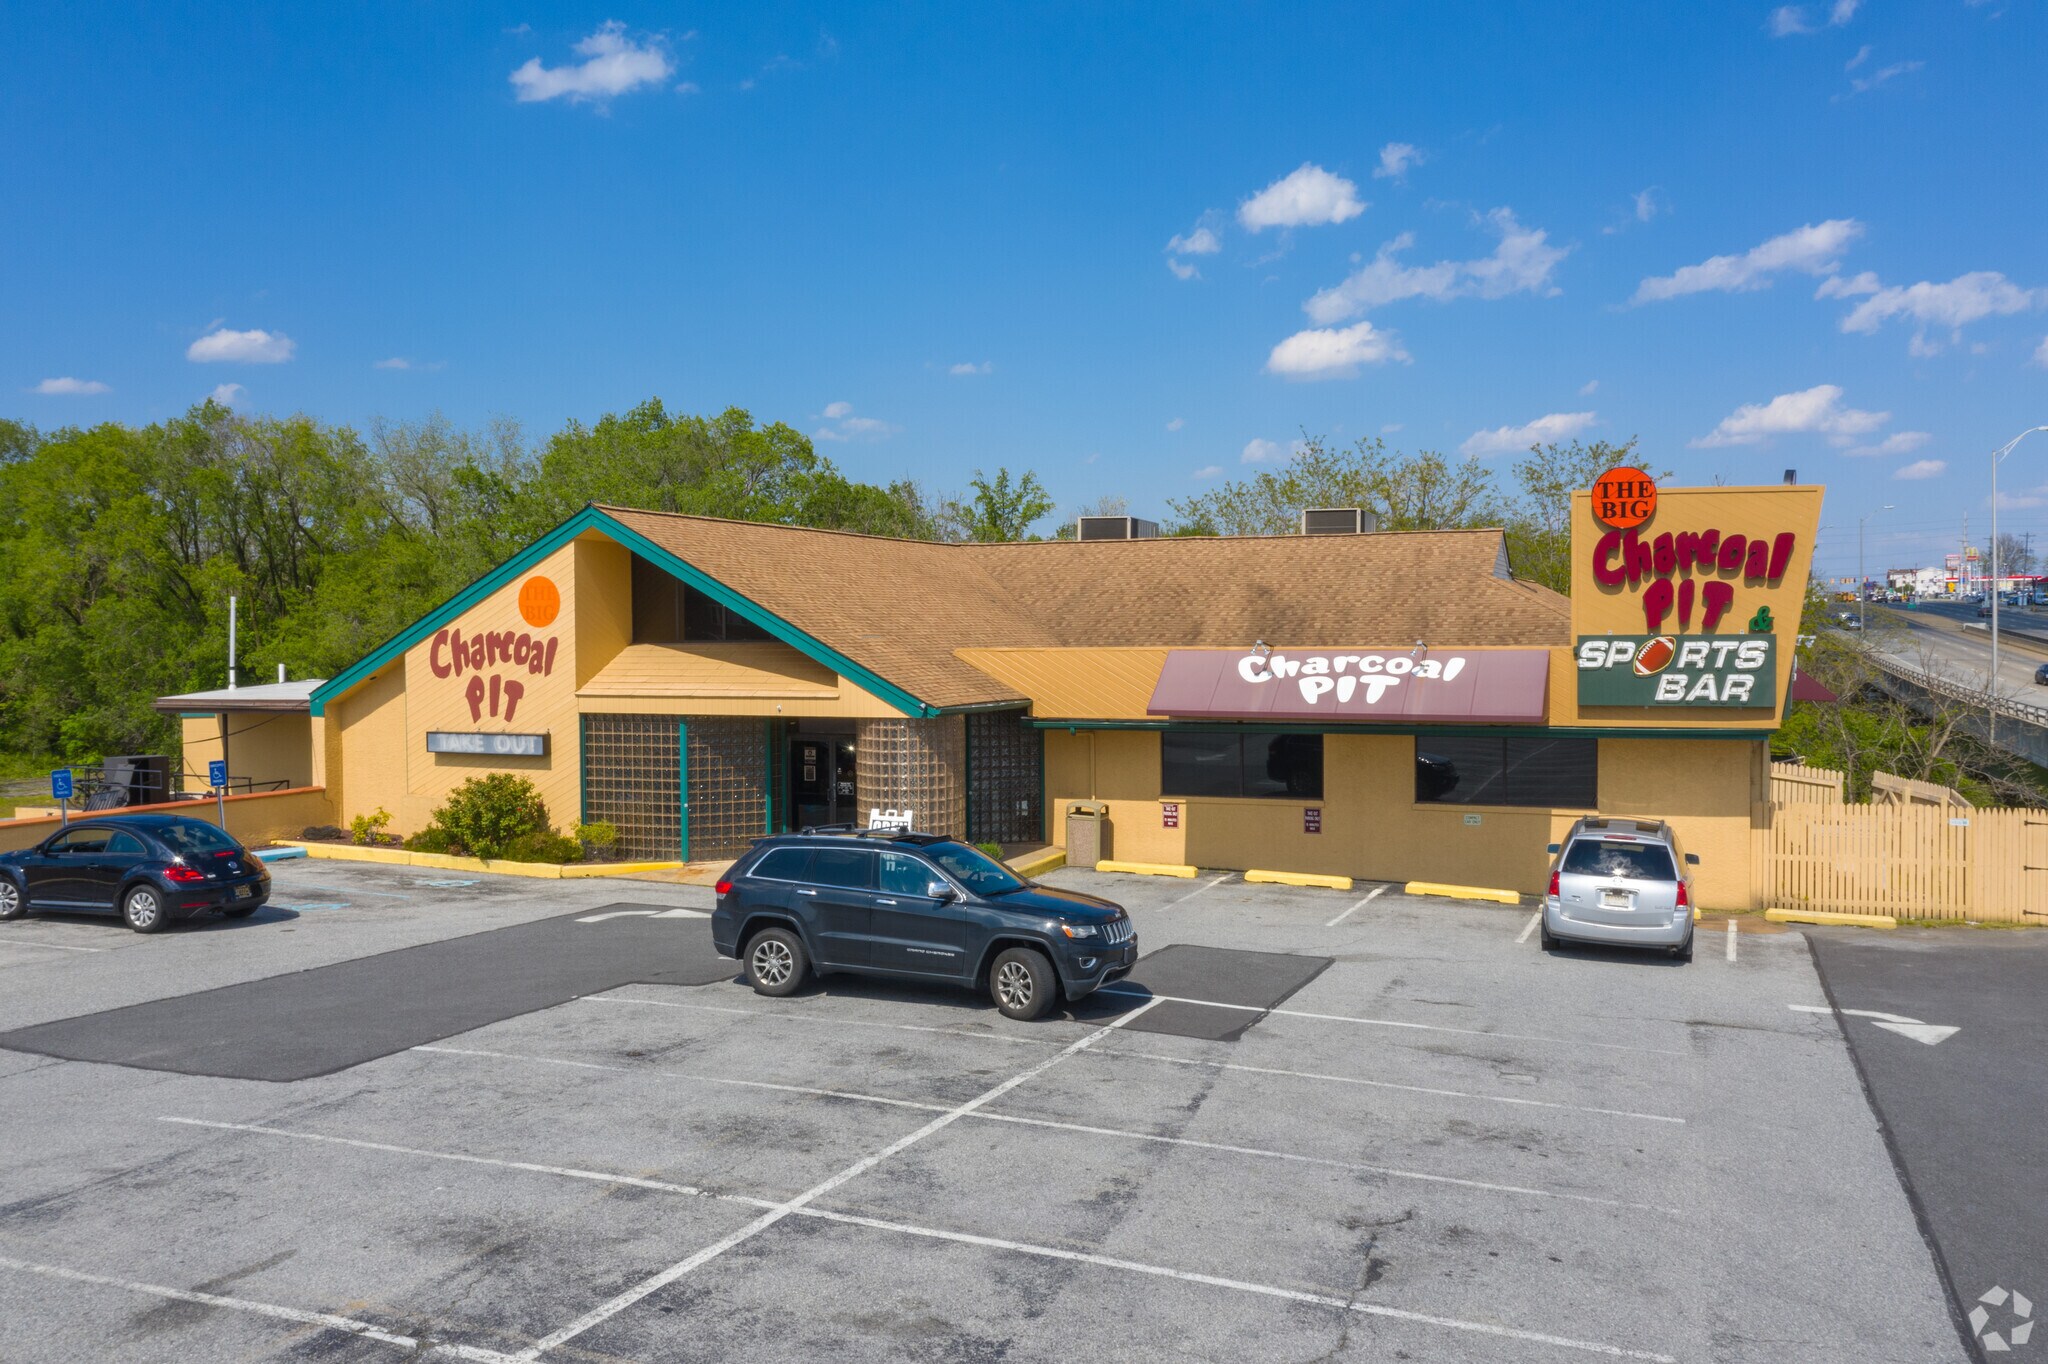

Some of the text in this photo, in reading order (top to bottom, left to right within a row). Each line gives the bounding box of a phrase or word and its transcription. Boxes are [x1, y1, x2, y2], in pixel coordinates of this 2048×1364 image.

[1597, 480, 1653, 499] THE
[1600, 500, 1650, 520] BIG
[1593, 528, 1796, 586] Charcoal
[525, 604, 555, 620] BIG
[1642, 577, 1734, 629] PIT
[1749, 605, 1775, 631] &
[430, 628, 559, 679] Charcoal
[1238, 655, 1466, 683] Charcoal
[465, 674, 525, 724] PIT
[1298, 674, 1401, 705] PIT
[1654, 673, 1755, 702] BAR
[436, 733, 537, 754] TAKE OUT
